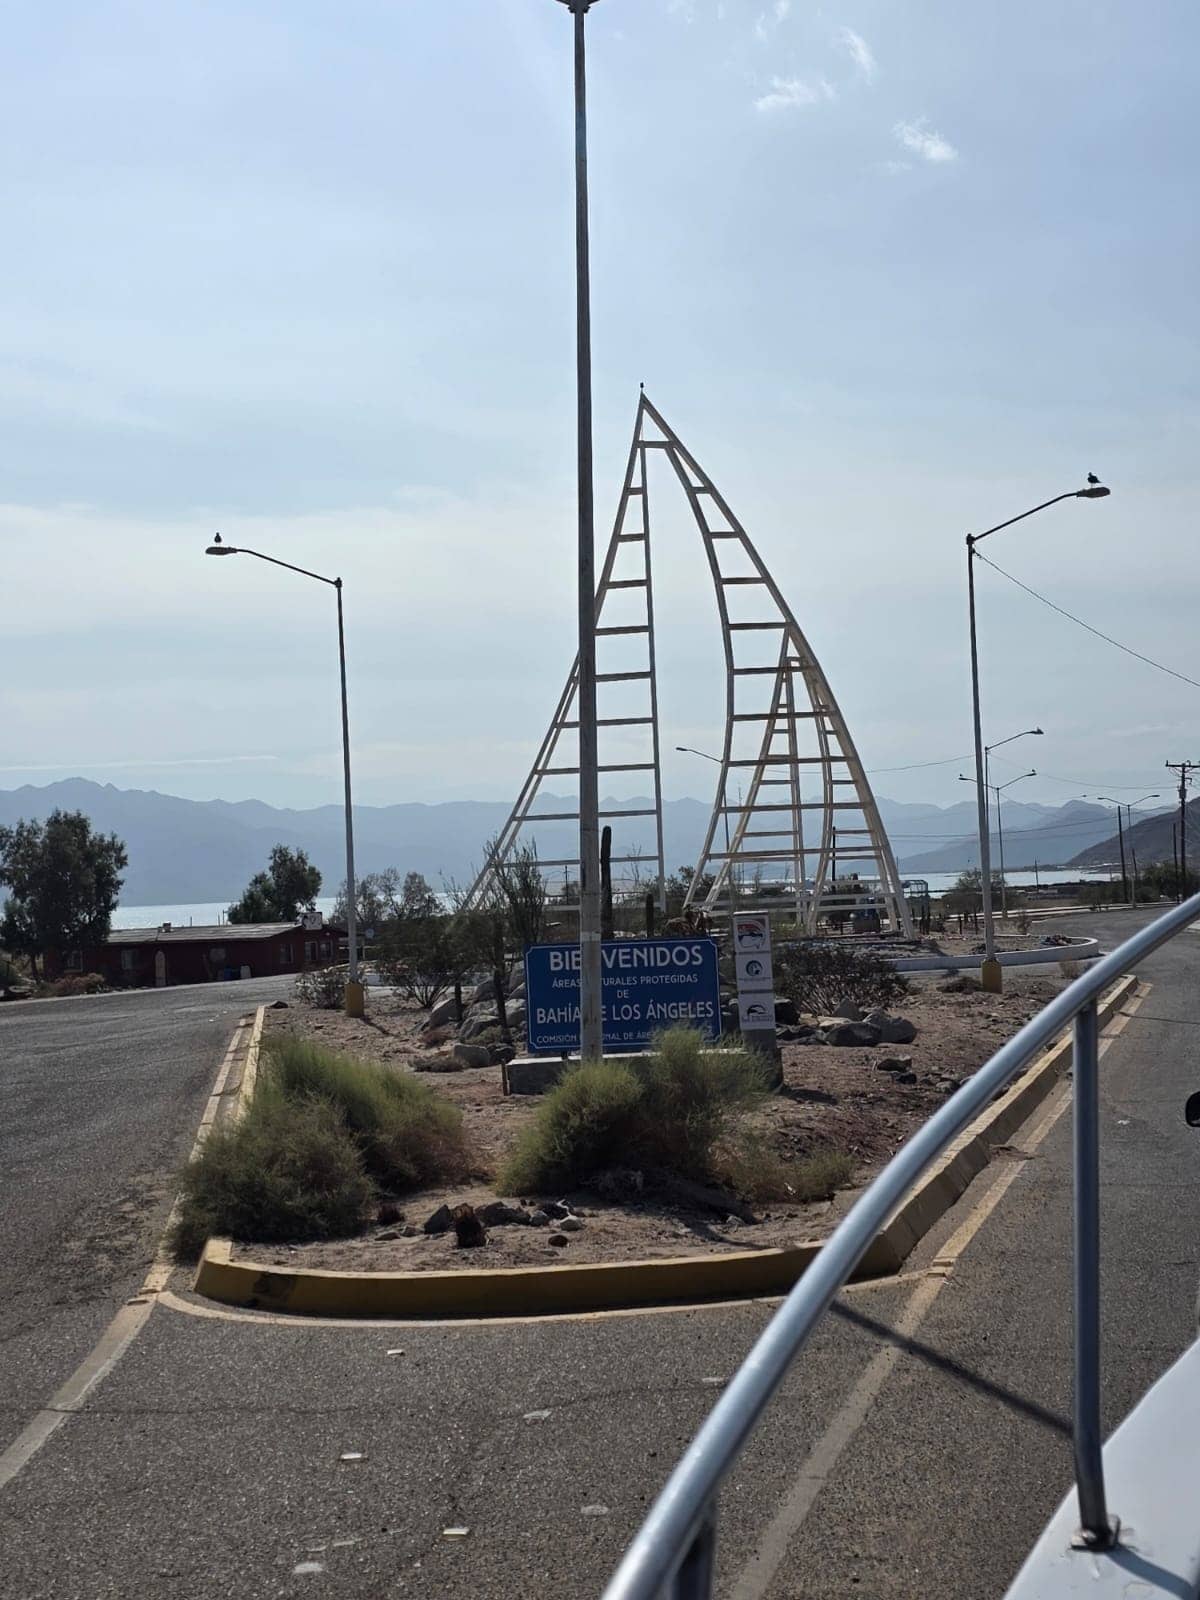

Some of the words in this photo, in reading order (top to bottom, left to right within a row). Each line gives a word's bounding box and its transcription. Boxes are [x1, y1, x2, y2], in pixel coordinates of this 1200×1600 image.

[550, 945, 703, 971] BIEVENIDOS
[640, 973, 698, 985] PROTEGIDAS
[617, 989, 630, 999] DE
[612, 1003, 641, 1021] LOS
[646, 999, 714, 1020] ÁNGELES
